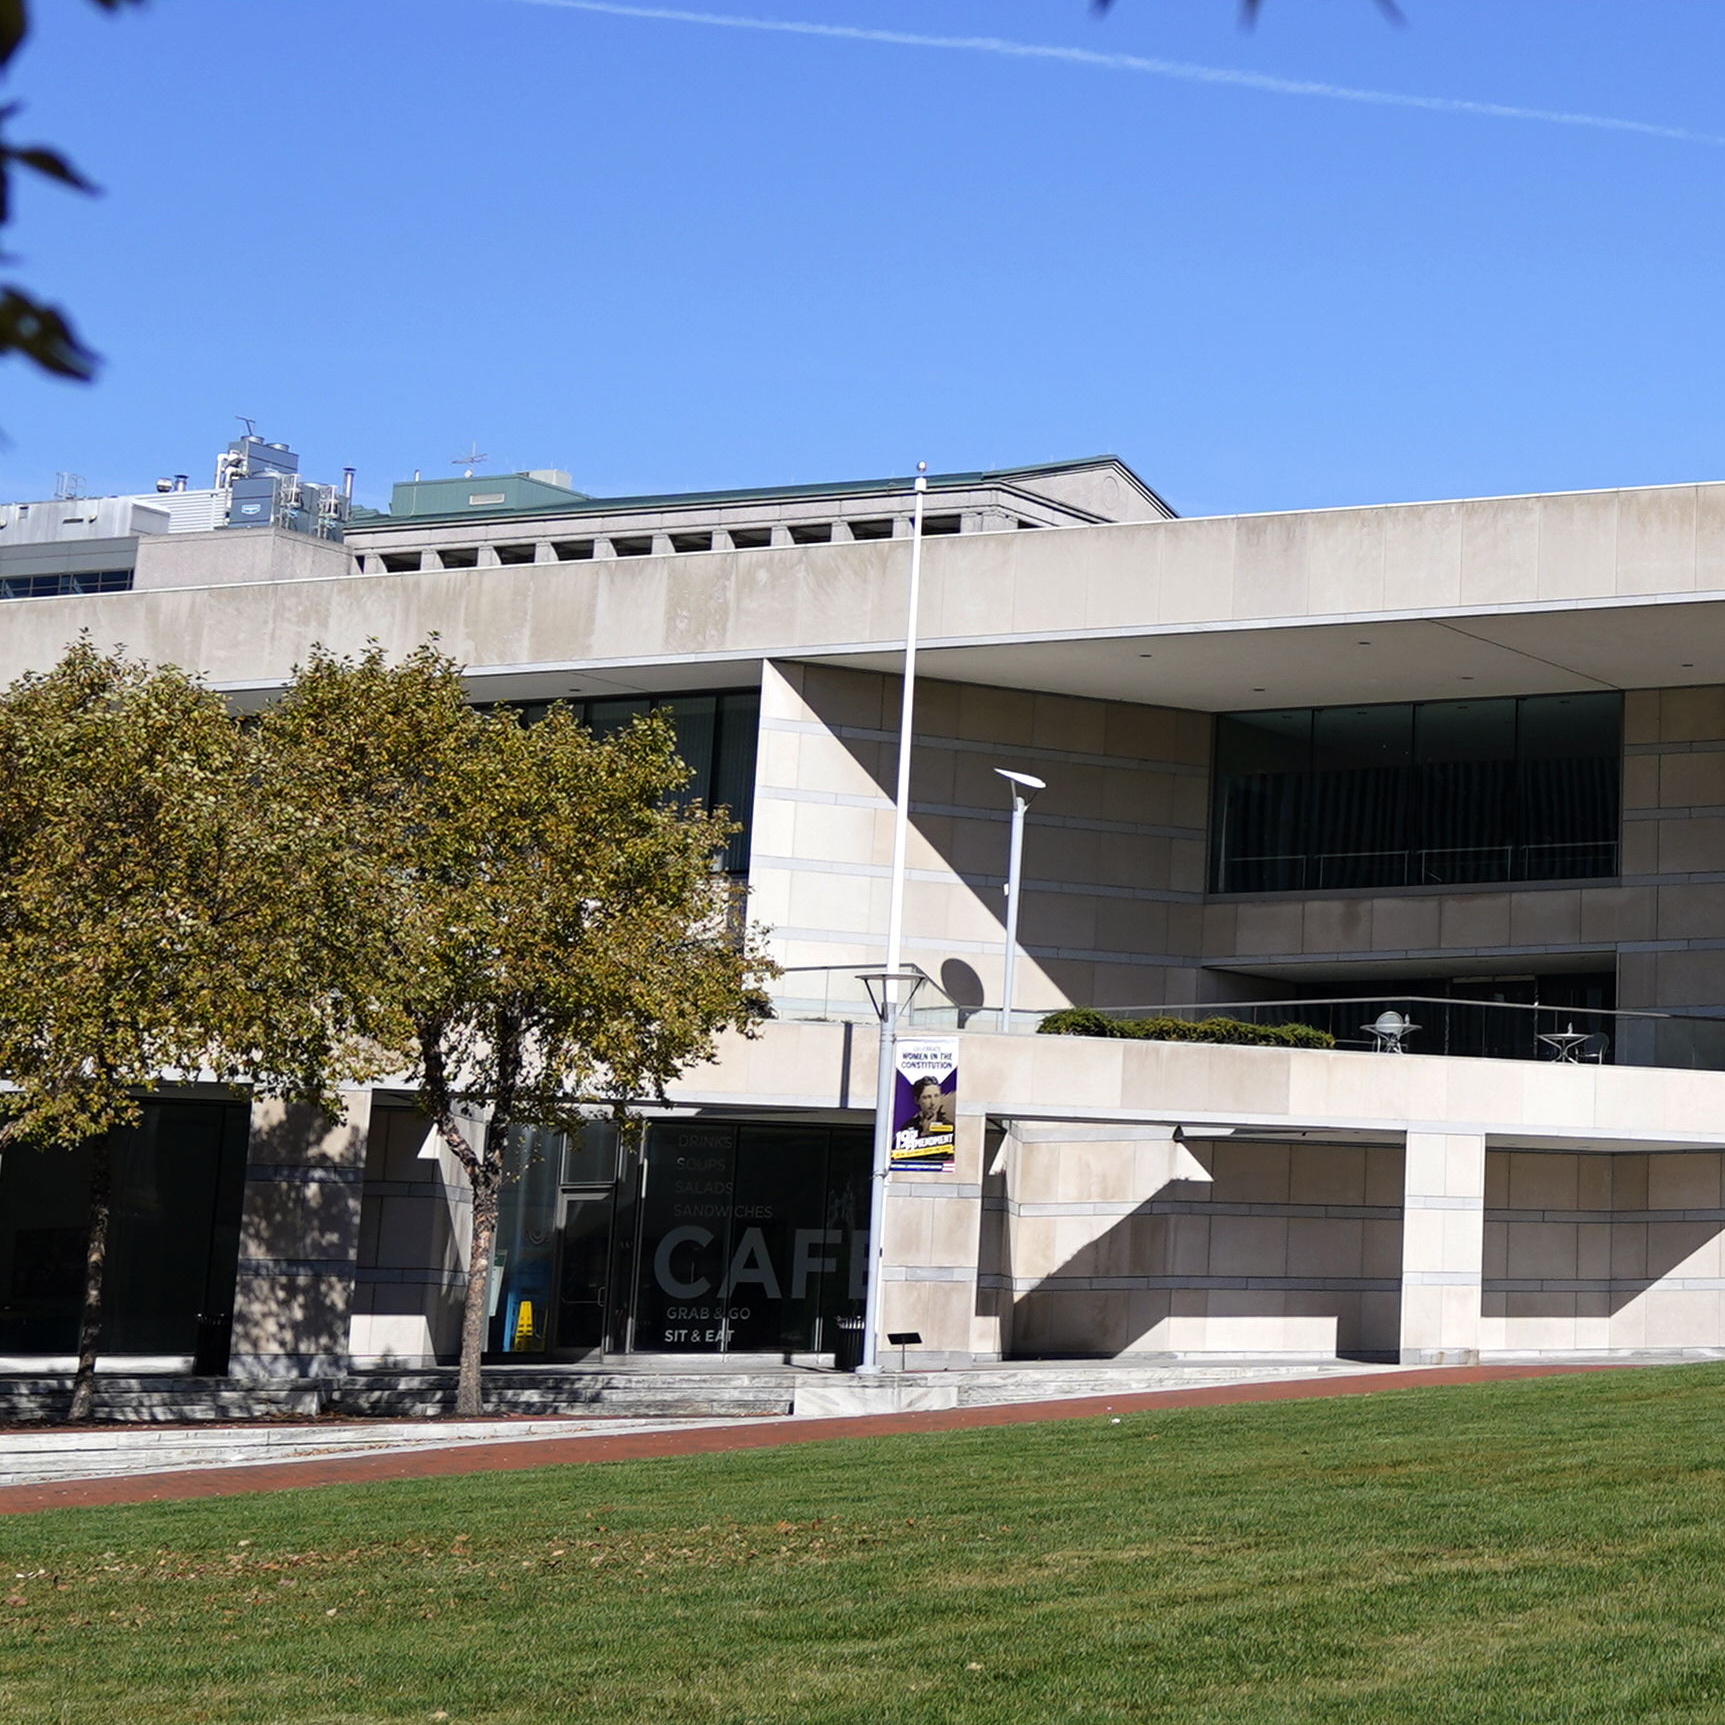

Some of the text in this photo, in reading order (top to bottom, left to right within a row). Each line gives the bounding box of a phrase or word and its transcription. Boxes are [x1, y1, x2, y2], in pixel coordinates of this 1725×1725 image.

[902, 1052, 928, 1060] WOMEN
[940, 1052, 953, 1060] THE
[901, 1061, 953, 1069] CONSTITUTION
[678, 1134, 733, 1149] DRINKS
[676, 1156, 726, 1171] SOUPS
[675, 1181, 734, 1195] SALADS
[673, 1204, 773, 1219] SANDWICHES
[666, 1306, 710, 1320] GRAB
[728, 1306, 751, 1320] GO
[664, 1329, 735, 1343] SIT & EAT
